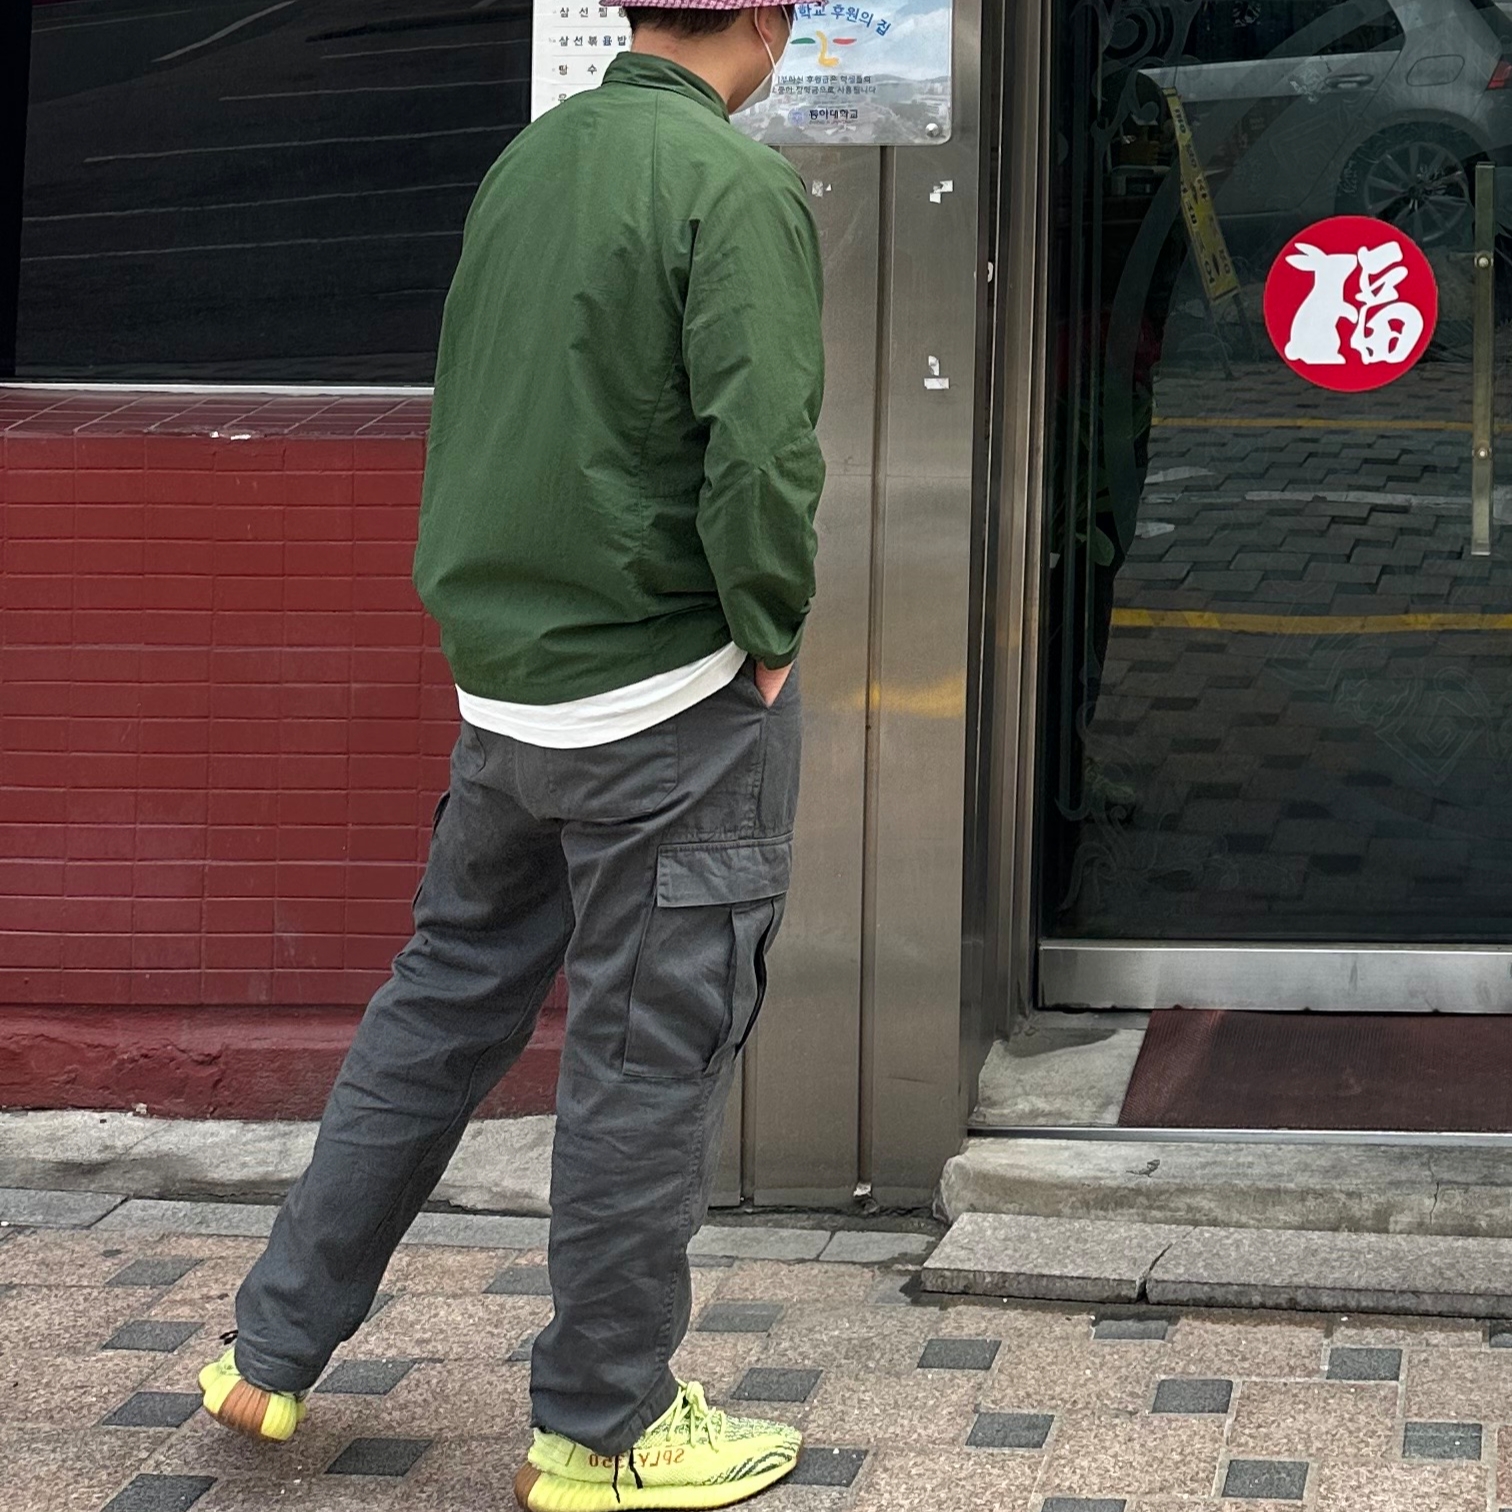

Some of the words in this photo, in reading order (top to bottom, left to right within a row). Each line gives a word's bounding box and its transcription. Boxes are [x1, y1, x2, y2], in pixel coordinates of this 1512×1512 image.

[793, 3, 827, 21] 학교
[831, 3, 874, 28] 후원의
[876, 18, 892, 37] 집
[809, 109, 858, 120] 동아대학교
